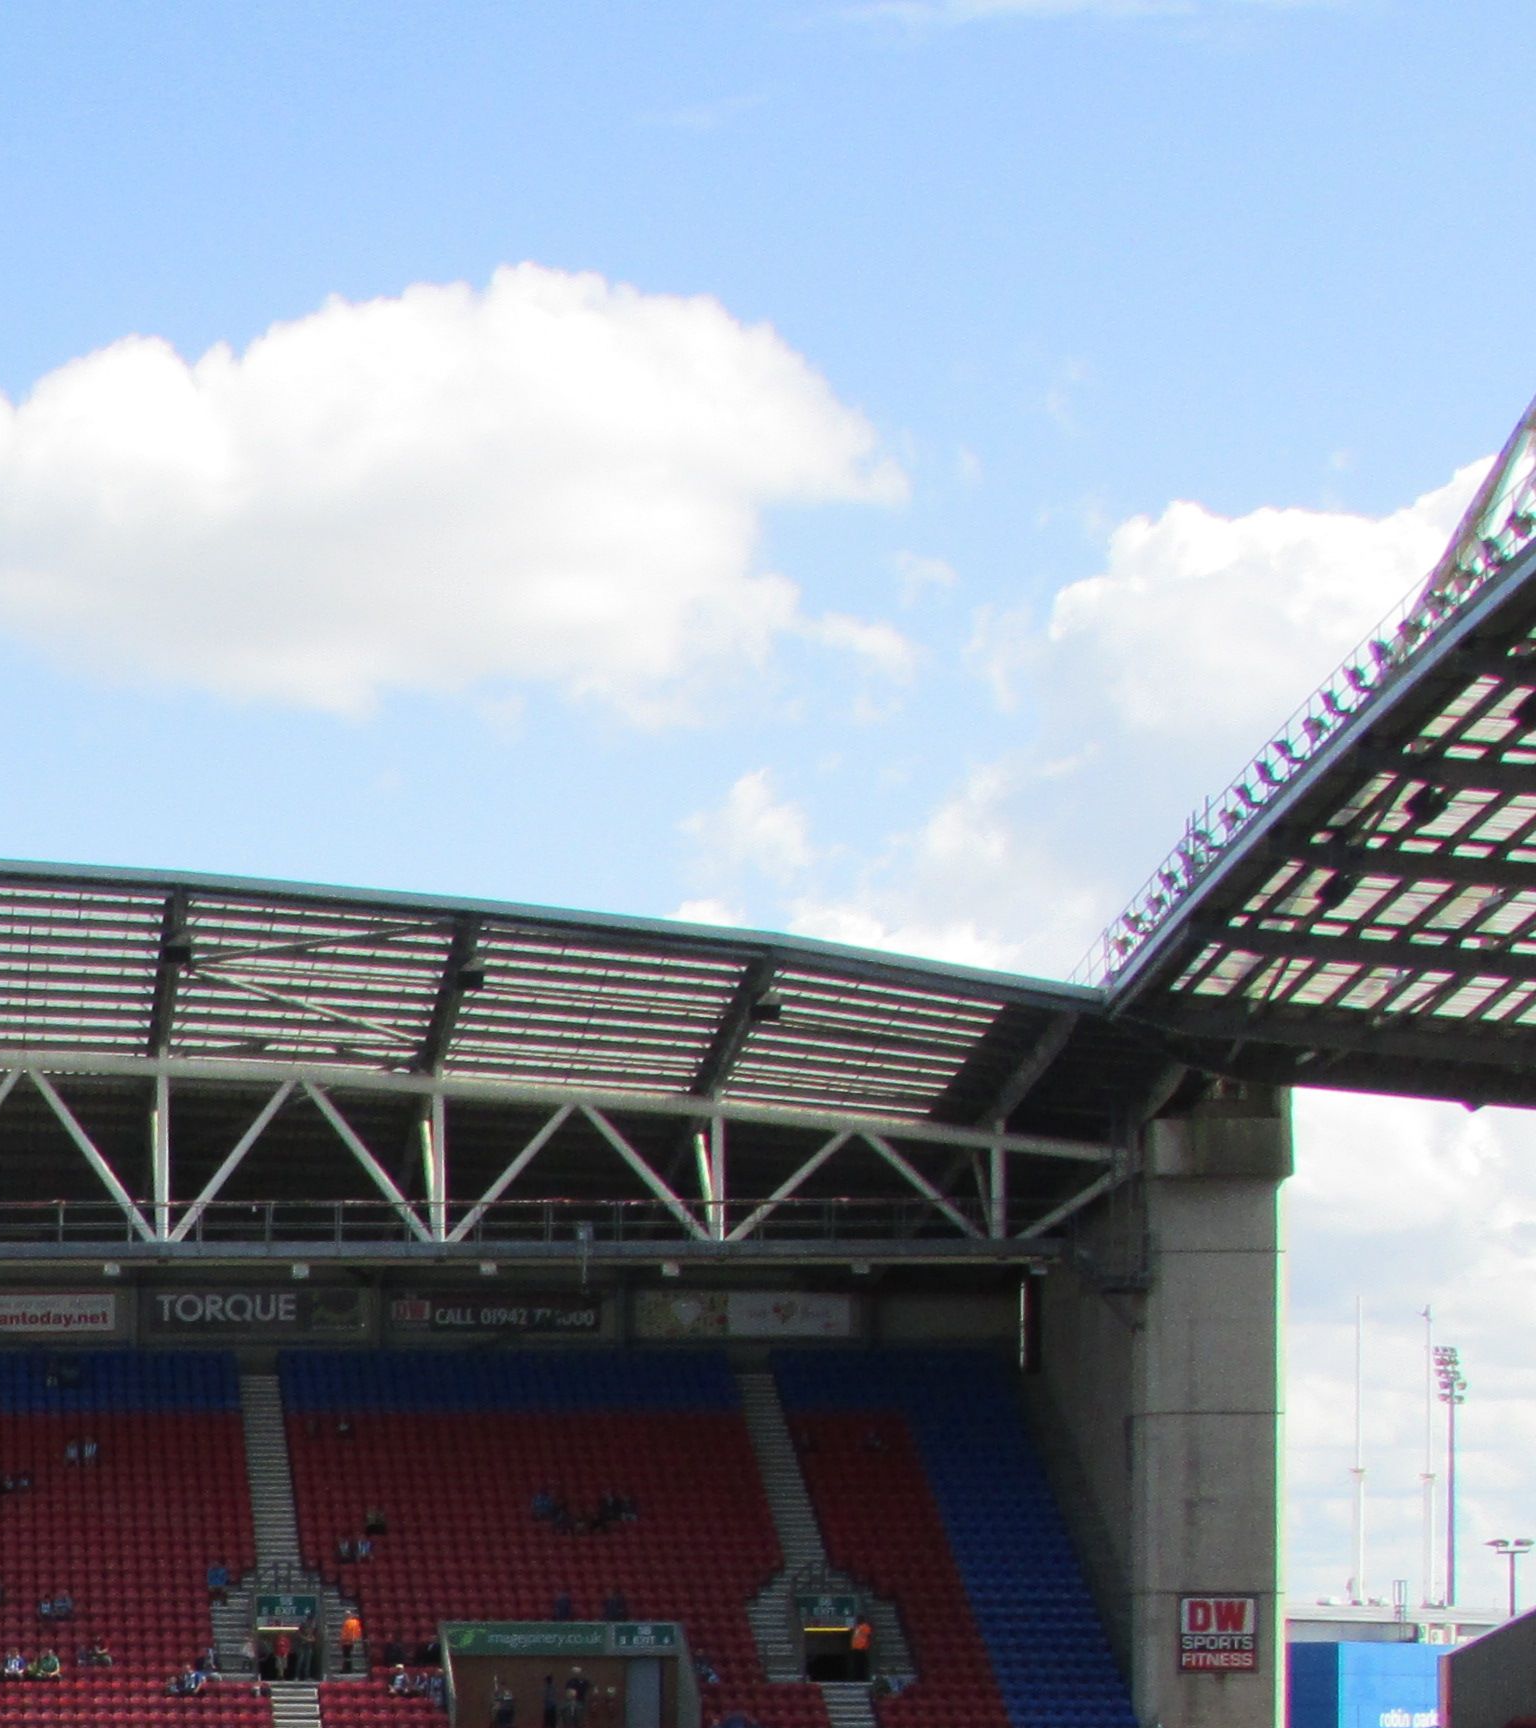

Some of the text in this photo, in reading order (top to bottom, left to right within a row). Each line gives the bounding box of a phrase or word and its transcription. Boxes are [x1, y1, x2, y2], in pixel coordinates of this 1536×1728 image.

[156, 1294, 297, 1322] TORQUE
[435, 1308, 476, 1325] CALL
[480, 1308, 528, 1325] 01942
[274, 1606, 296, 1615] EXIT
[1188, 1600, 1246, 1632] DW
[632, 1635, 655, 1645] EXIT
[1181, 1636, 1254, 1650] SPORTS
[1181, 1652, 1254, 1667] FITNESS
[1379, 1709, 1411, 1728] robin
